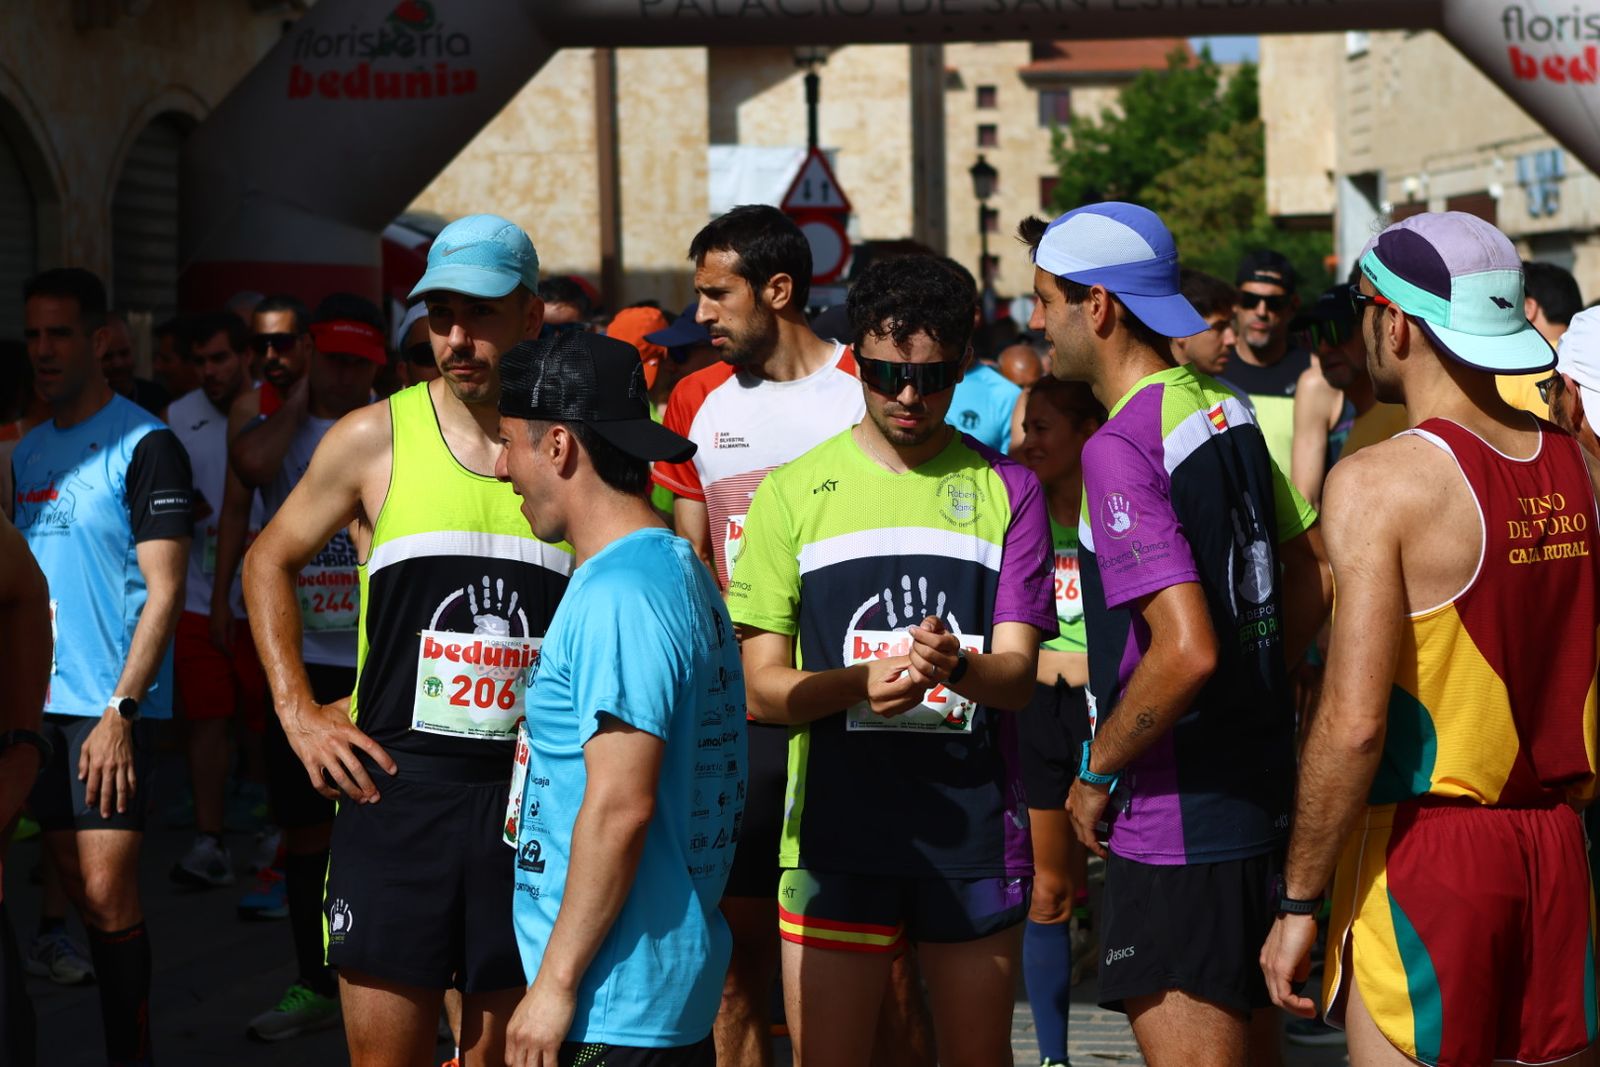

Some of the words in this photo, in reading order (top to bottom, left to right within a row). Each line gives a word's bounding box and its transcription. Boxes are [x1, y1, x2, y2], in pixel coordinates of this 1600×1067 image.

[288, 60, 477, 99] bedunia
[1518, 493, 1566, 515] VINO
[1507, 521, 1532, 539] DE
[1533, 513, 1587, 536] TORO
[1508, 547, 1541, 564] CAJA
[1543, 541, 1589, 560] RURAL
[313, 591, 354, 613] 244
[449, 675, 516, 711] 206
